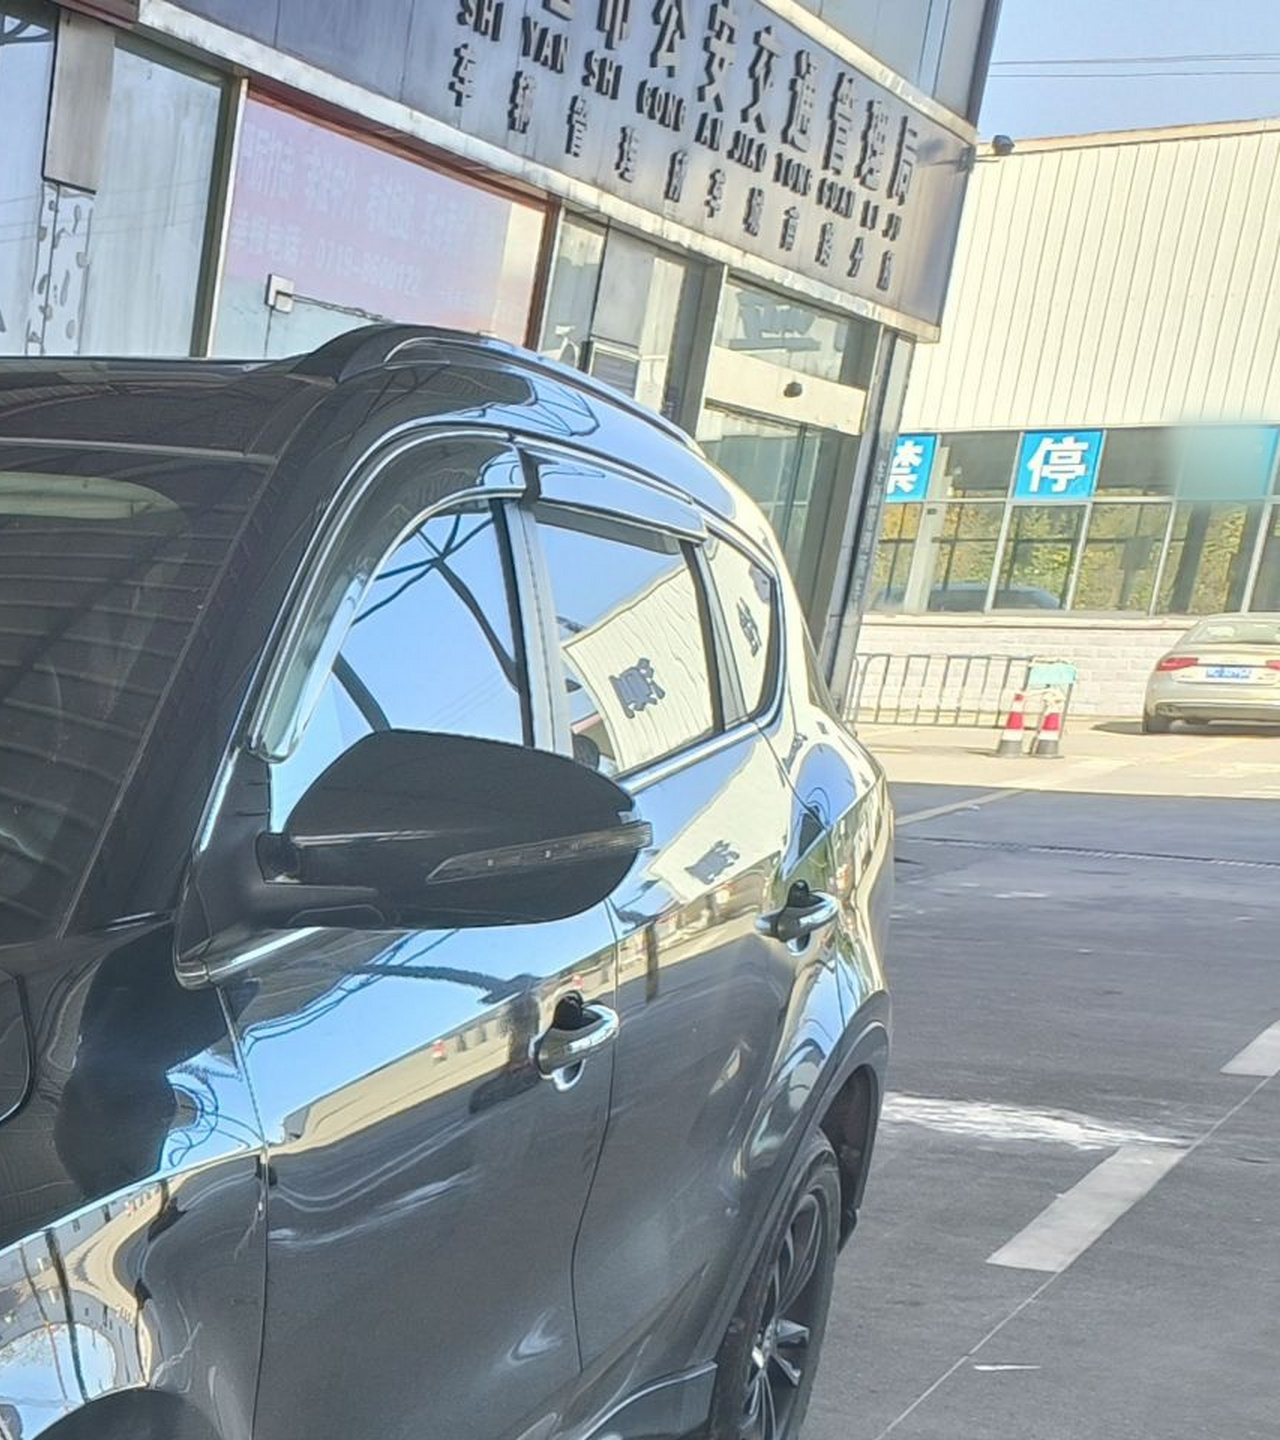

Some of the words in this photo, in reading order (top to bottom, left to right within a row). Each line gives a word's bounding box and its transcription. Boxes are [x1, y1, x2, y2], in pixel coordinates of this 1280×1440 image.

[543, 0, 917, 207] 市公安交通管理局
[1026, 435, 1090, 493] 停
